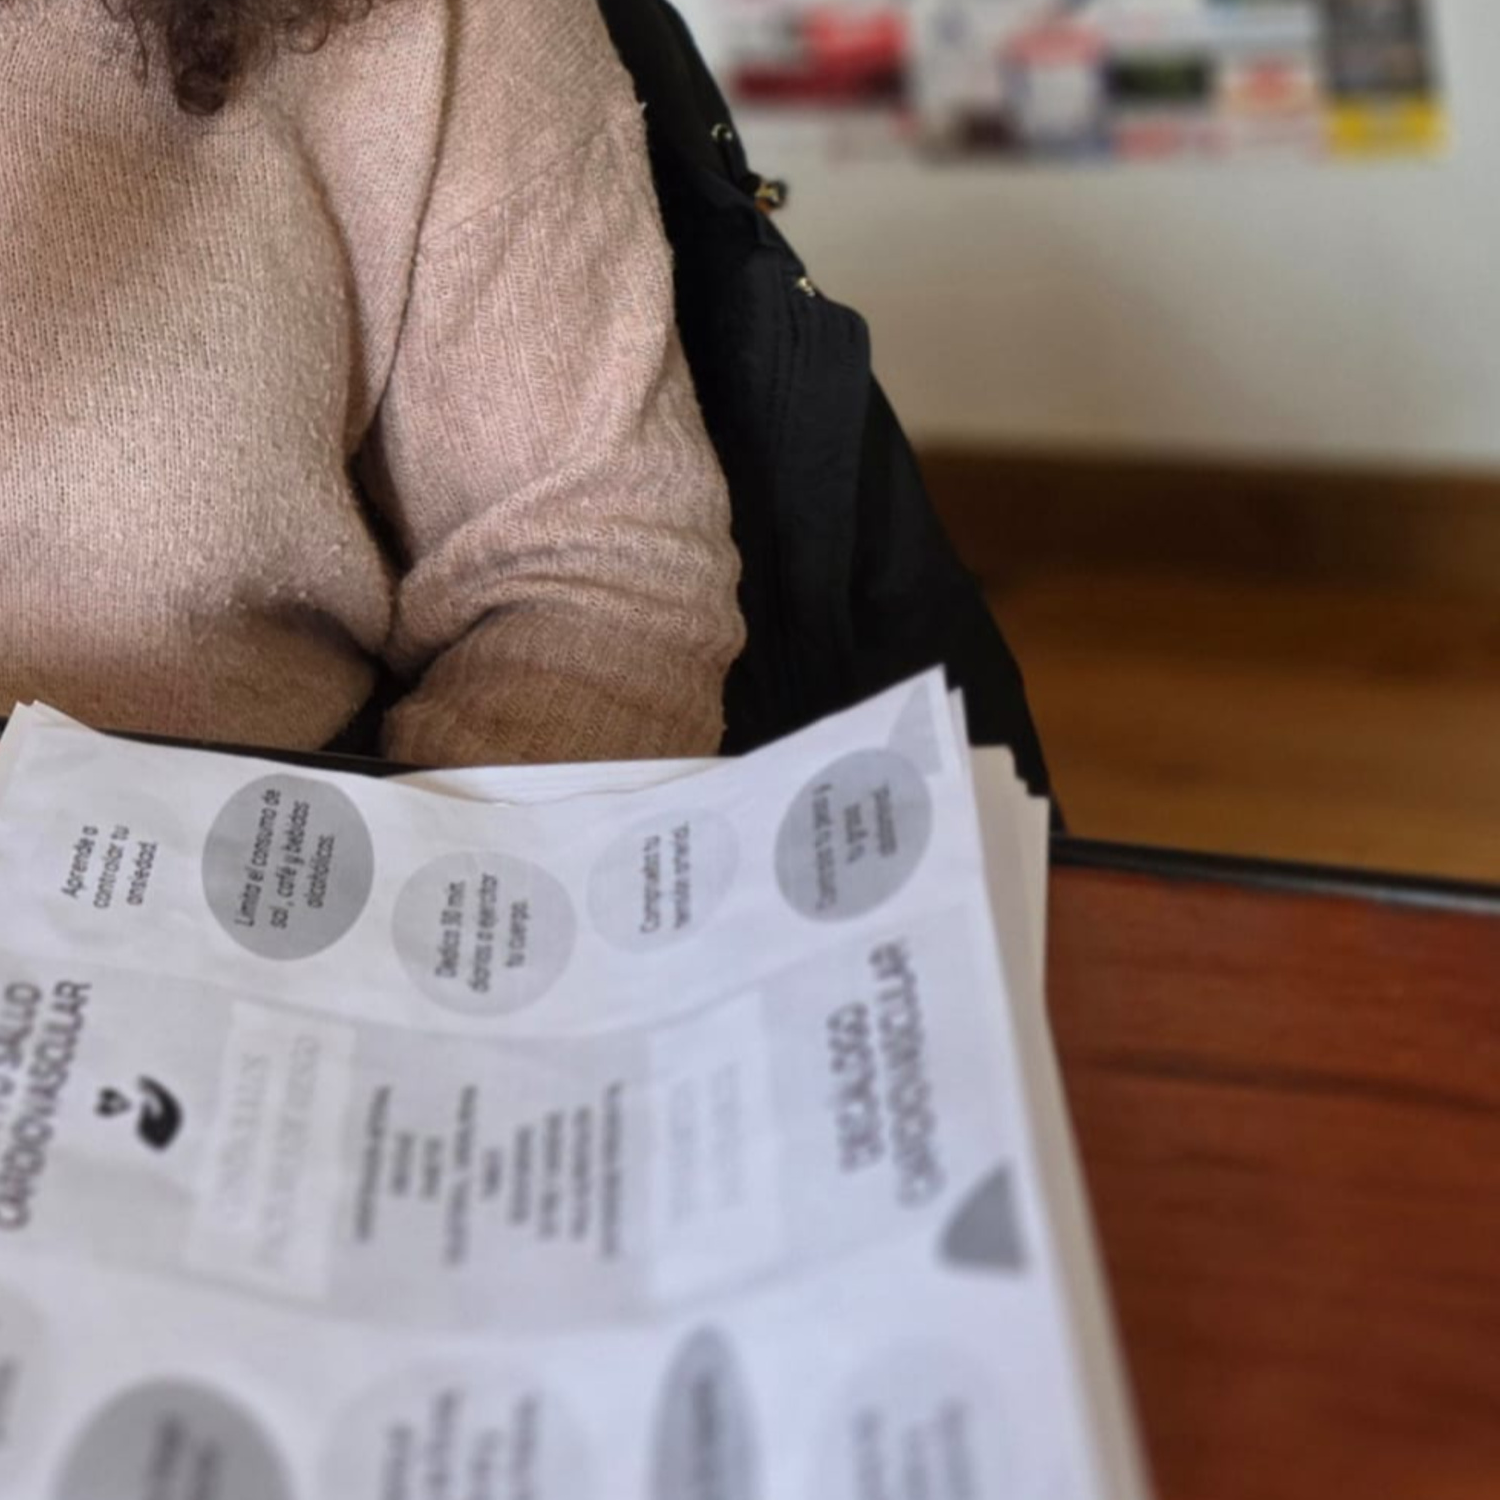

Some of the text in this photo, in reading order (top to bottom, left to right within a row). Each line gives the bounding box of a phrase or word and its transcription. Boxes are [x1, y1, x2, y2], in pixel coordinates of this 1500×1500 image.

[282, 800, 310, 853] bebidas
[61, 837, 96, 899] Aprende
[93, 824, 130, 909] controlar tu
[234, 788, 281, 927] Limita el consumo de
[275, 865, 297, 898] café
[283, 854, 305, 866] y
